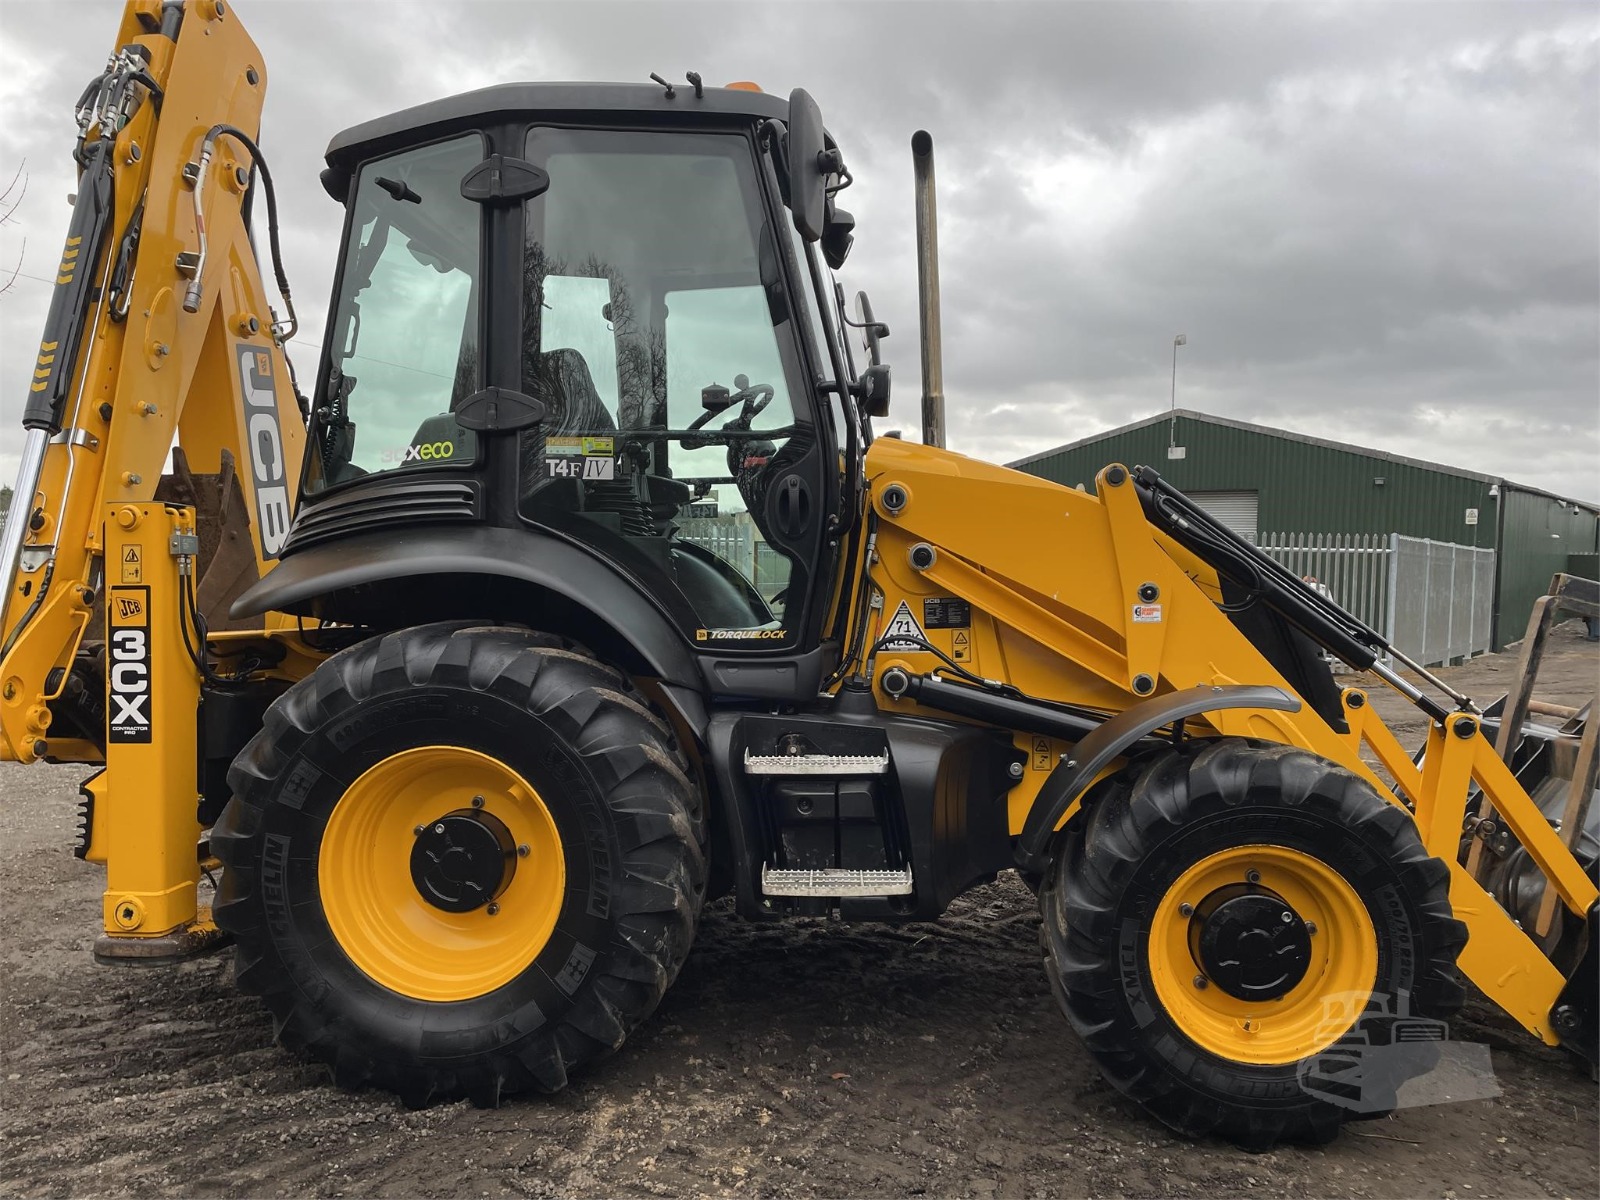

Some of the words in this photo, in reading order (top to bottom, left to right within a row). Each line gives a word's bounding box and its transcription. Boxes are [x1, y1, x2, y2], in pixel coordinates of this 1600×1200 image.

[240, 350, 290, 557] JCB
[119, 598, 142, 617] JCB
[711, 630, 787, 640] TORQUELOCK
[896, 621, 911, 633] 71
[110, 629, 150, 725] 3CX
